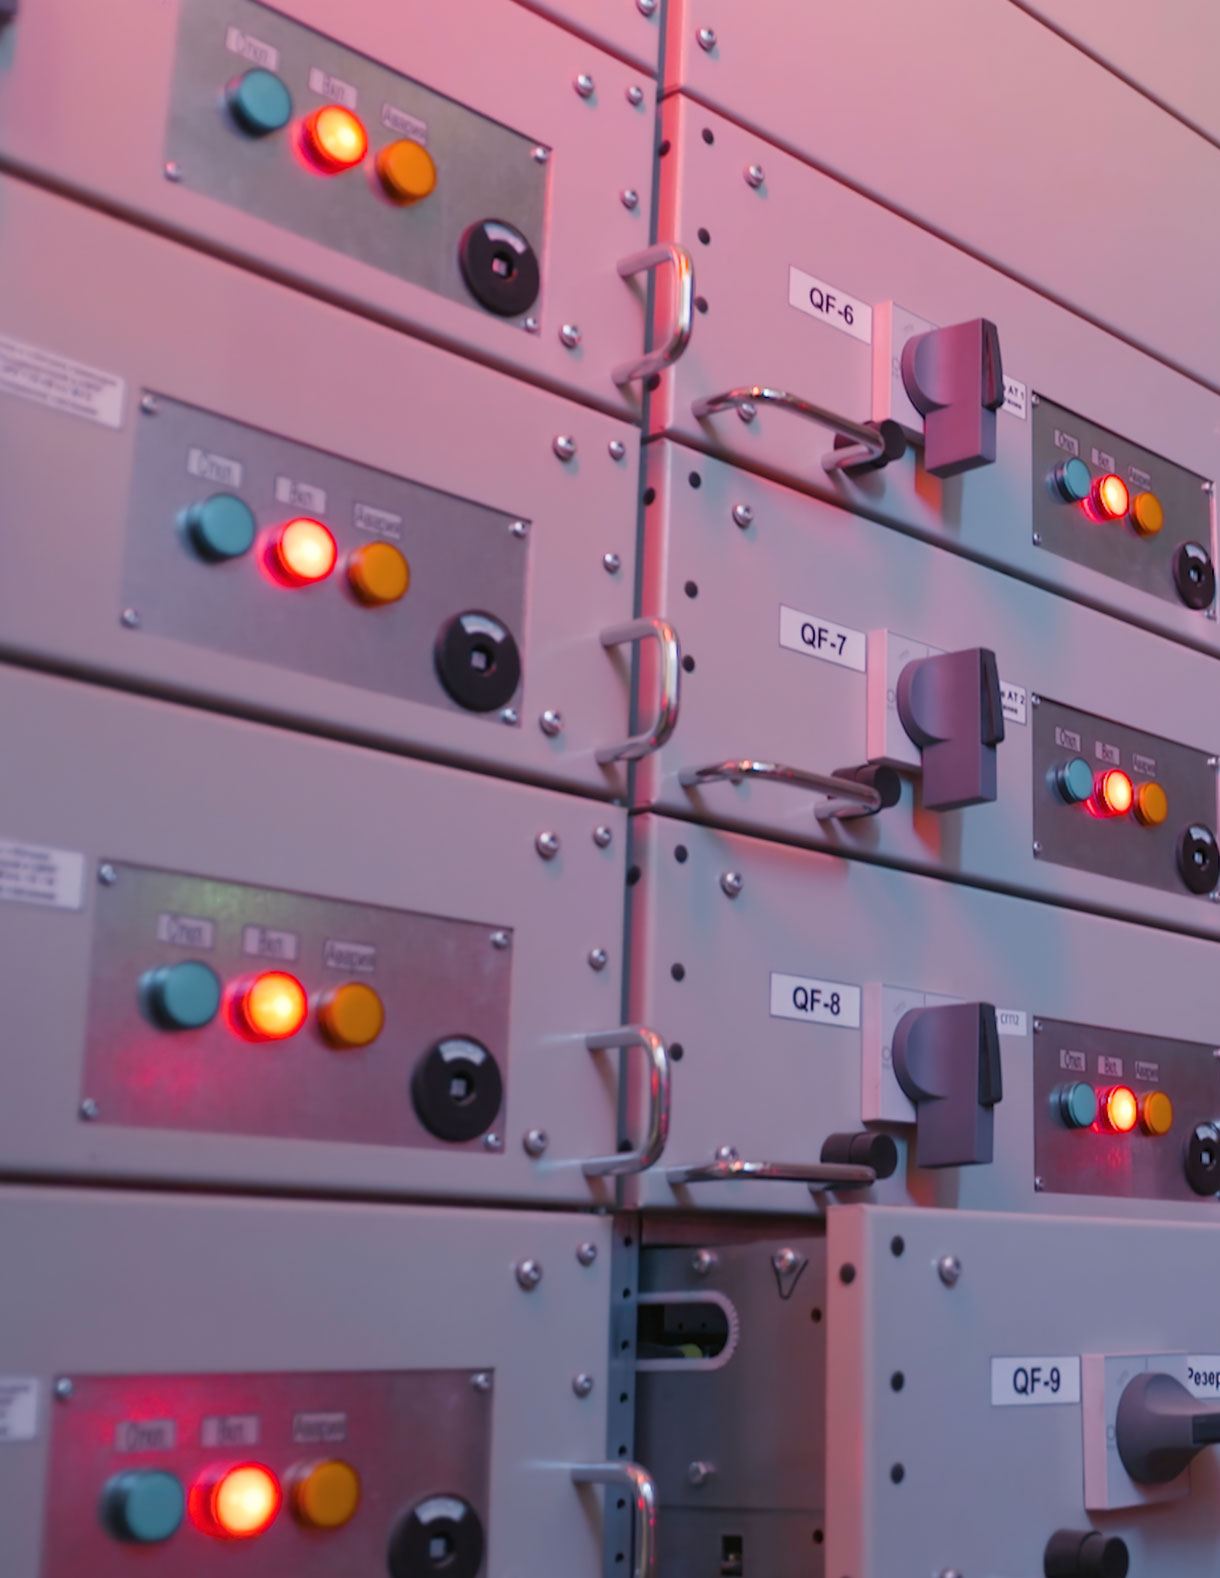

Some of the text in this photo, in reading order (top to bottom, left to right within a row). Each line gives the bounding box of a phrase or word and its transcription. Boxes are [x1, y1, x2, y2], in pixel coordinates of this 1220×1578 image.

[809, 287, 854, 326] QF-6
[801, 622, 847, 656] QF-7
[792, 986, 841, 1016] QF-8
[1012, 1367, 1061, 1395] QF-9
